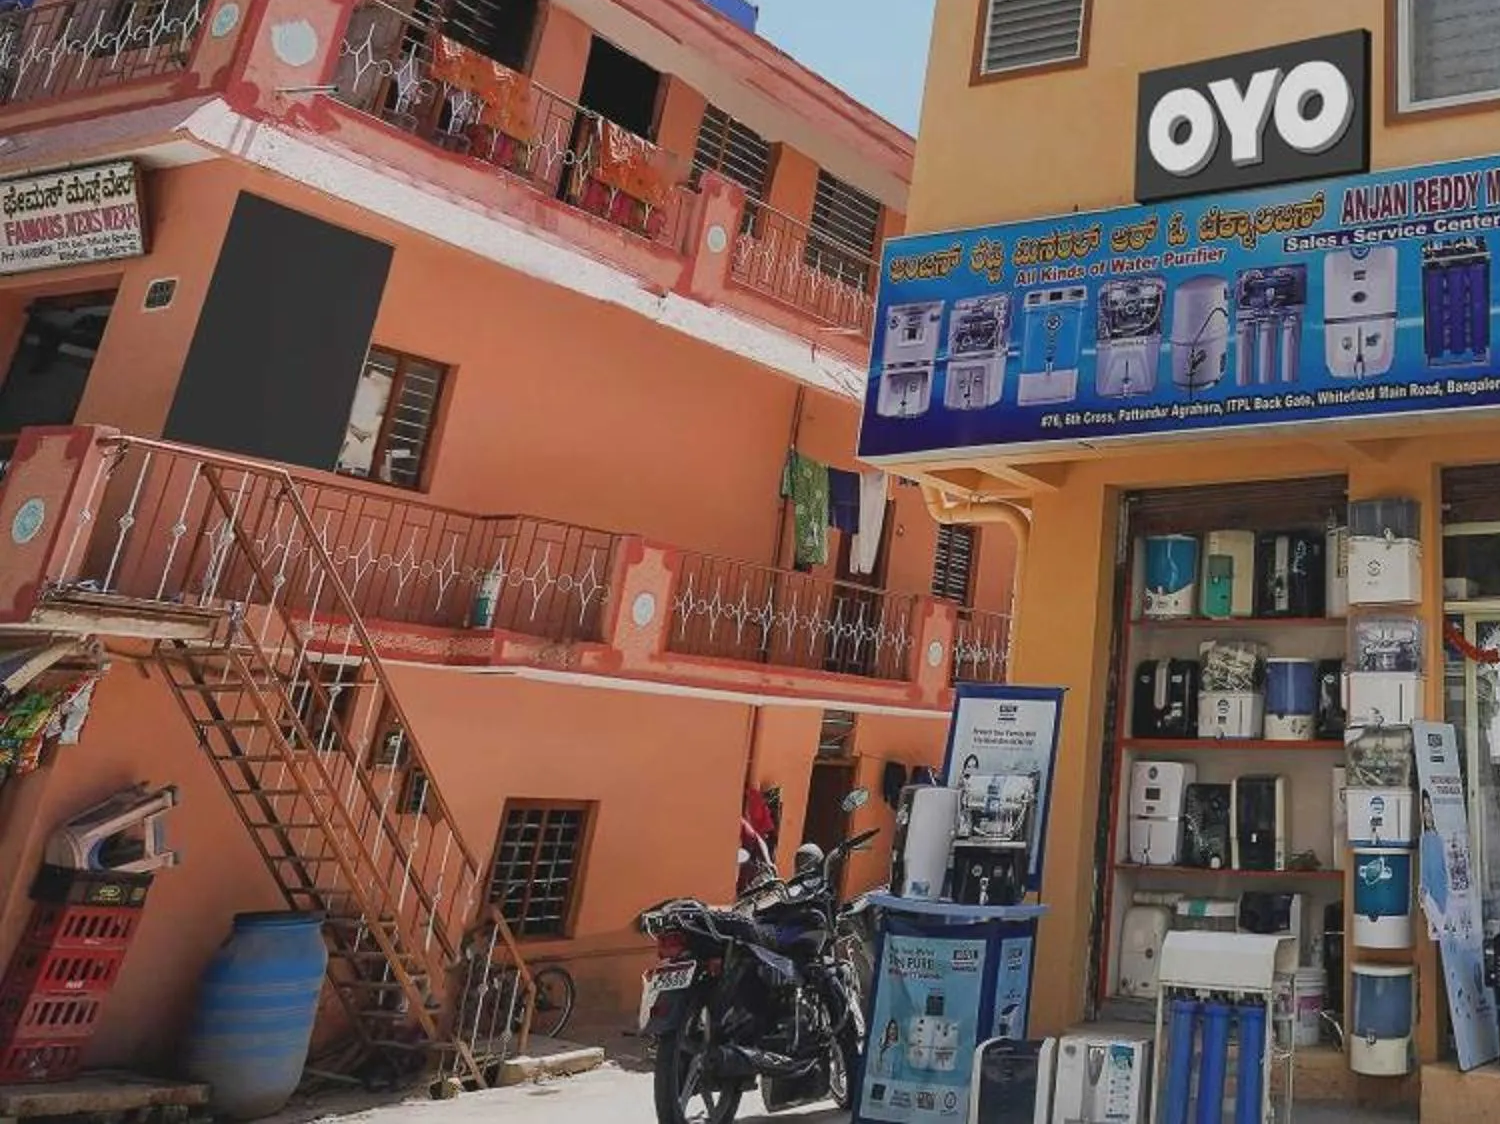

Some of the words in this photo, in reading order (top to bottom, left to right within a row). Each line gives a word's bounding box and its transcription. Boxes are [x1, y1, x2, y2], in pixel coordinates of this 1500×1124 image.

[1148, 60, 1354, 176] OYO
[1340, 182, 1408, 225] ANJAN
[1412, 172, 1481, 216] REDDY
[1287, 234, 1338, 251] Sales
[1354, 223, 1427, 243] Service
[1015, 269, 1036, 287] All
[1040, 262, 1085, 283] Kinds
[1089, 259, 1106, 276] of
[1110, 254, 1158, 275] Water
[1162, 246, 1226, 268] Purifier
[1254, 395, 1283, 410] Back
[1317, 387, 1375, 405] Whitefield
[1379, 384, 1407, 399] Main
[1409, 382, 1443, 397] Road,
